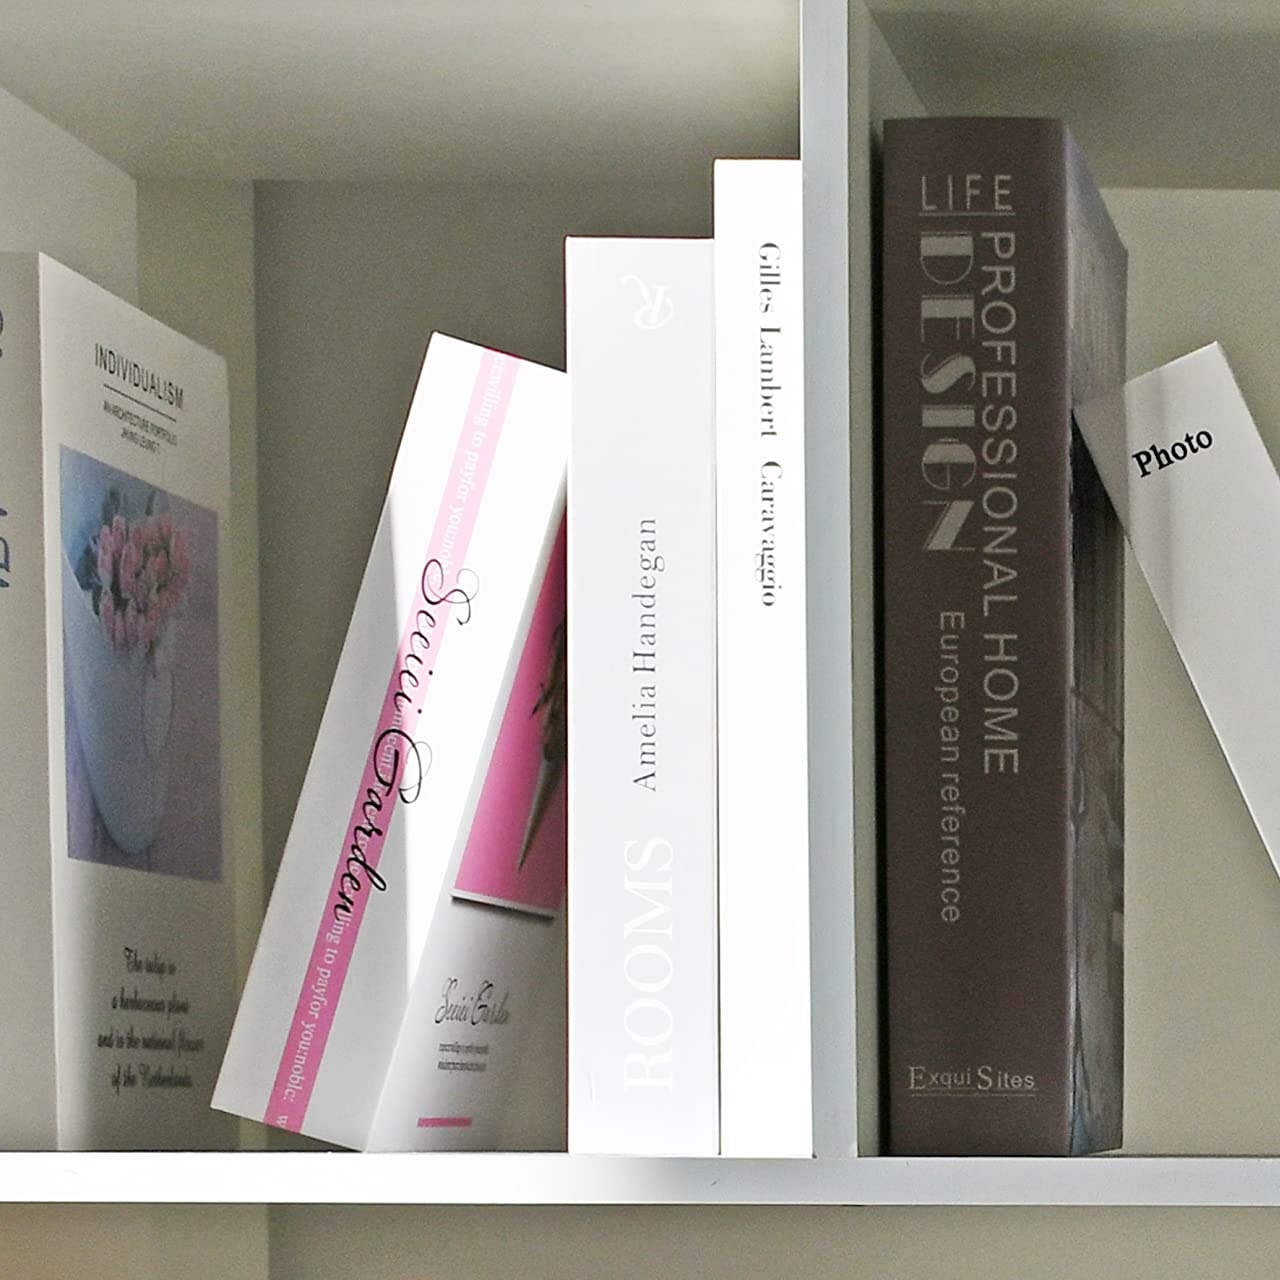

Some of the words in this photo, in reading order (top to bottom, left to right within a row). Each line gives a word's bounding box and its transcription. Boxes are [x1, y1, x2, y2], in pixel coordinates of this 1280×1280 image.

[920, 174, 1013, 211] LIFE
[758, 241, 782, 313] Gilles
[95, 343, 183, 409] INDIVIDUALISM
[758, 327, 782, 438] Lambert
[920, 230, 977, 552] DESIGN
[980, 231, 1018, 617] PROFESSIONAL
[1132, 429, 1214, 479] Photo
[630, 518, 666, 674] Handegan
[754, 460, 783, 607] Caravaggio
[630, 684, 657, 792] Amelia
[934, 610, 967, 763] European
[983, 633, 1020, 775] HOME
[940, 772, 967, 923] reference
[622, 836, 675, 1093] ROOMS
